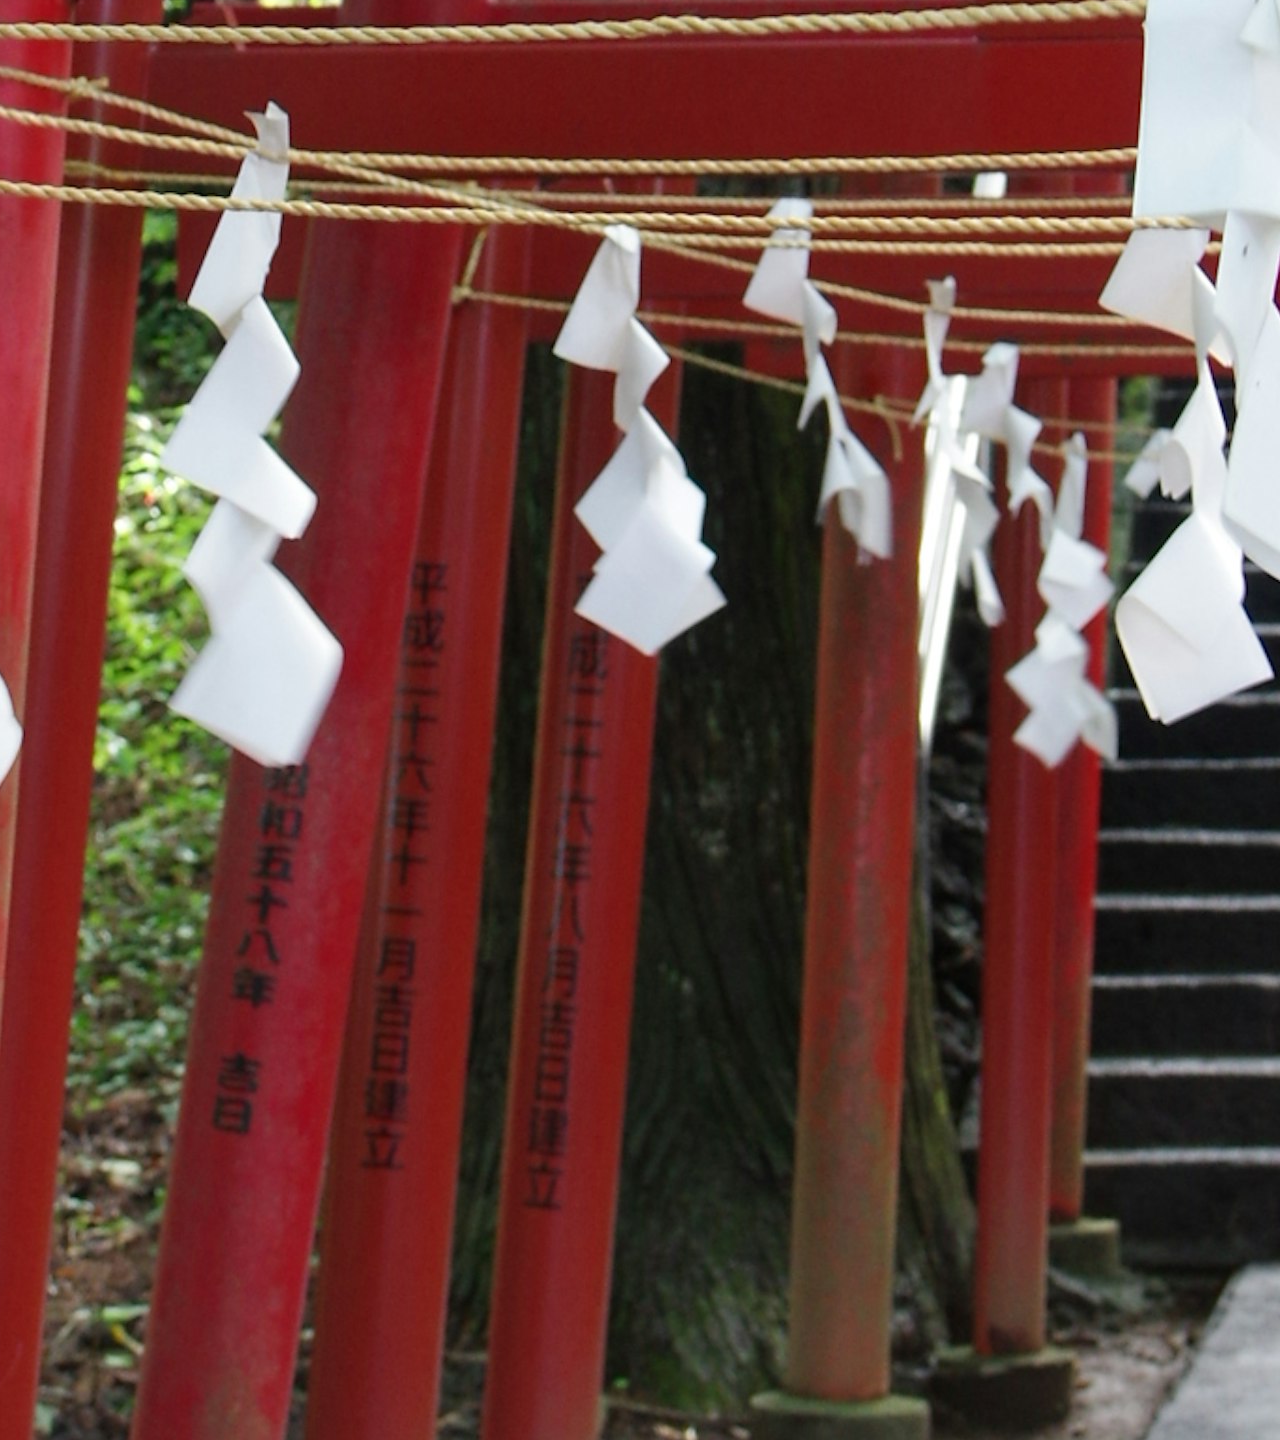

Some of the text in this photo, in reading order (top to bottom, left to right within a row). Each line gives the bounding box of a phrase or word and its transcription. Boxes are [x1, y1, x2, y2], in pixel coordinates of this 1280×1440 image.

[524, 570, 608, 1212] 成二十六年八月吉日建立
